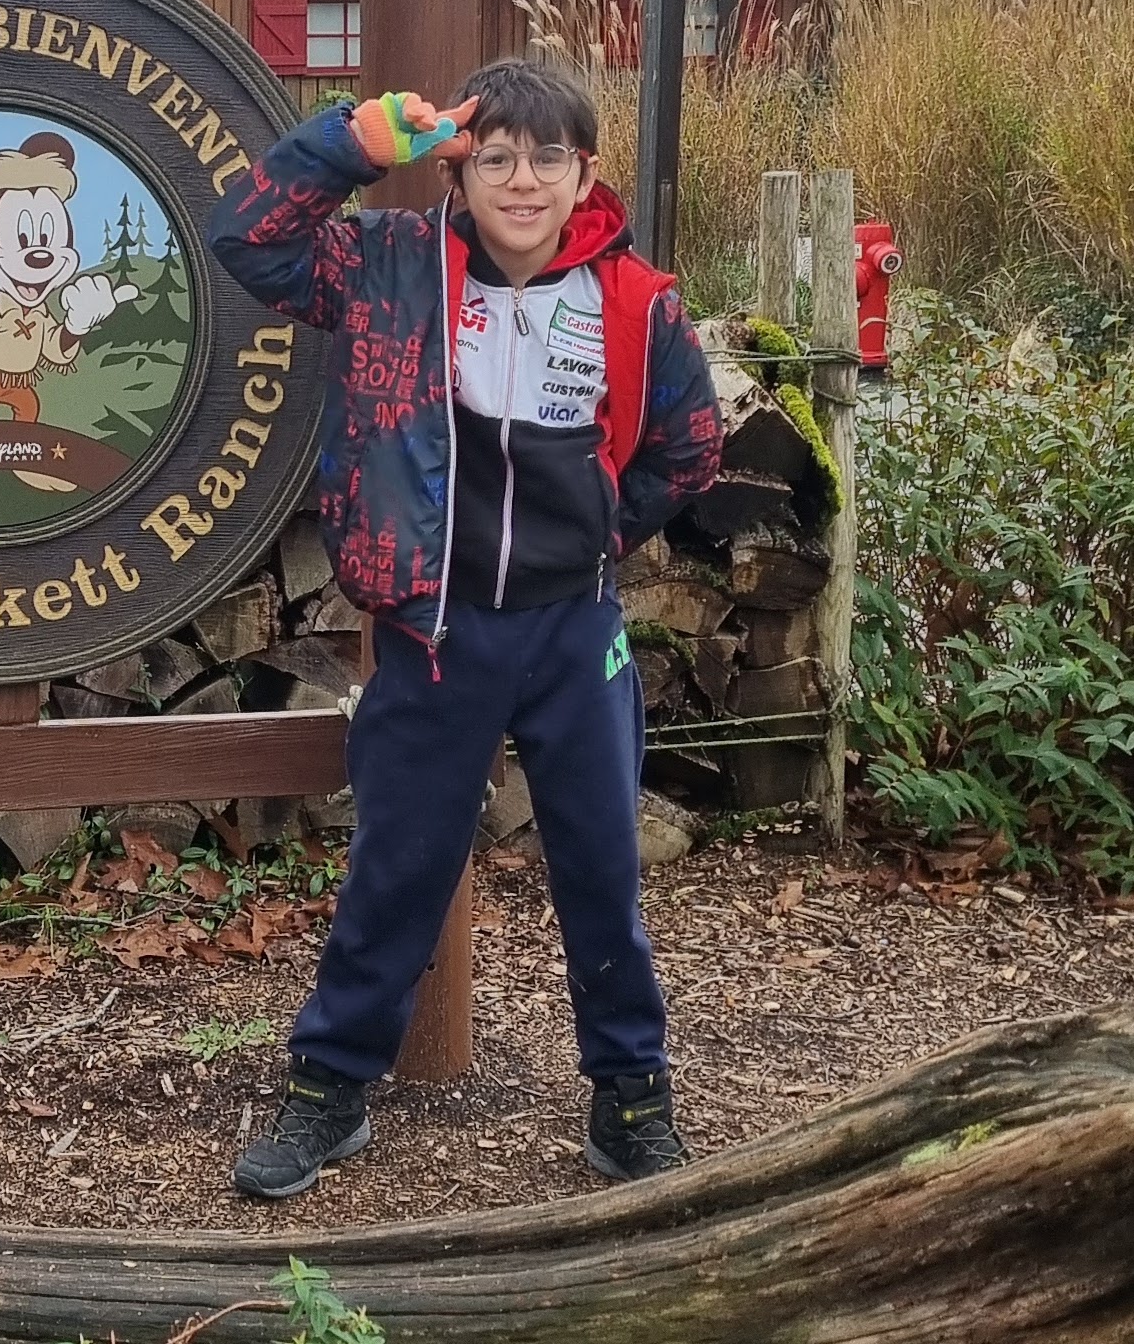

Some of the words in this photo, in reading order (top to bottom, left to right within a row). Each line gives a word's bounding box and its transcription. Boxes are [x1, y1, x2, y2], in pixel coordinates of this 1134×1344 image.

[567, 316, 604, 335] Castro
[547, 355, 597, 378] LAVOR
[542, 381, 596, 398] CUSTOM
[141, 322, 296, 562] Ranch
